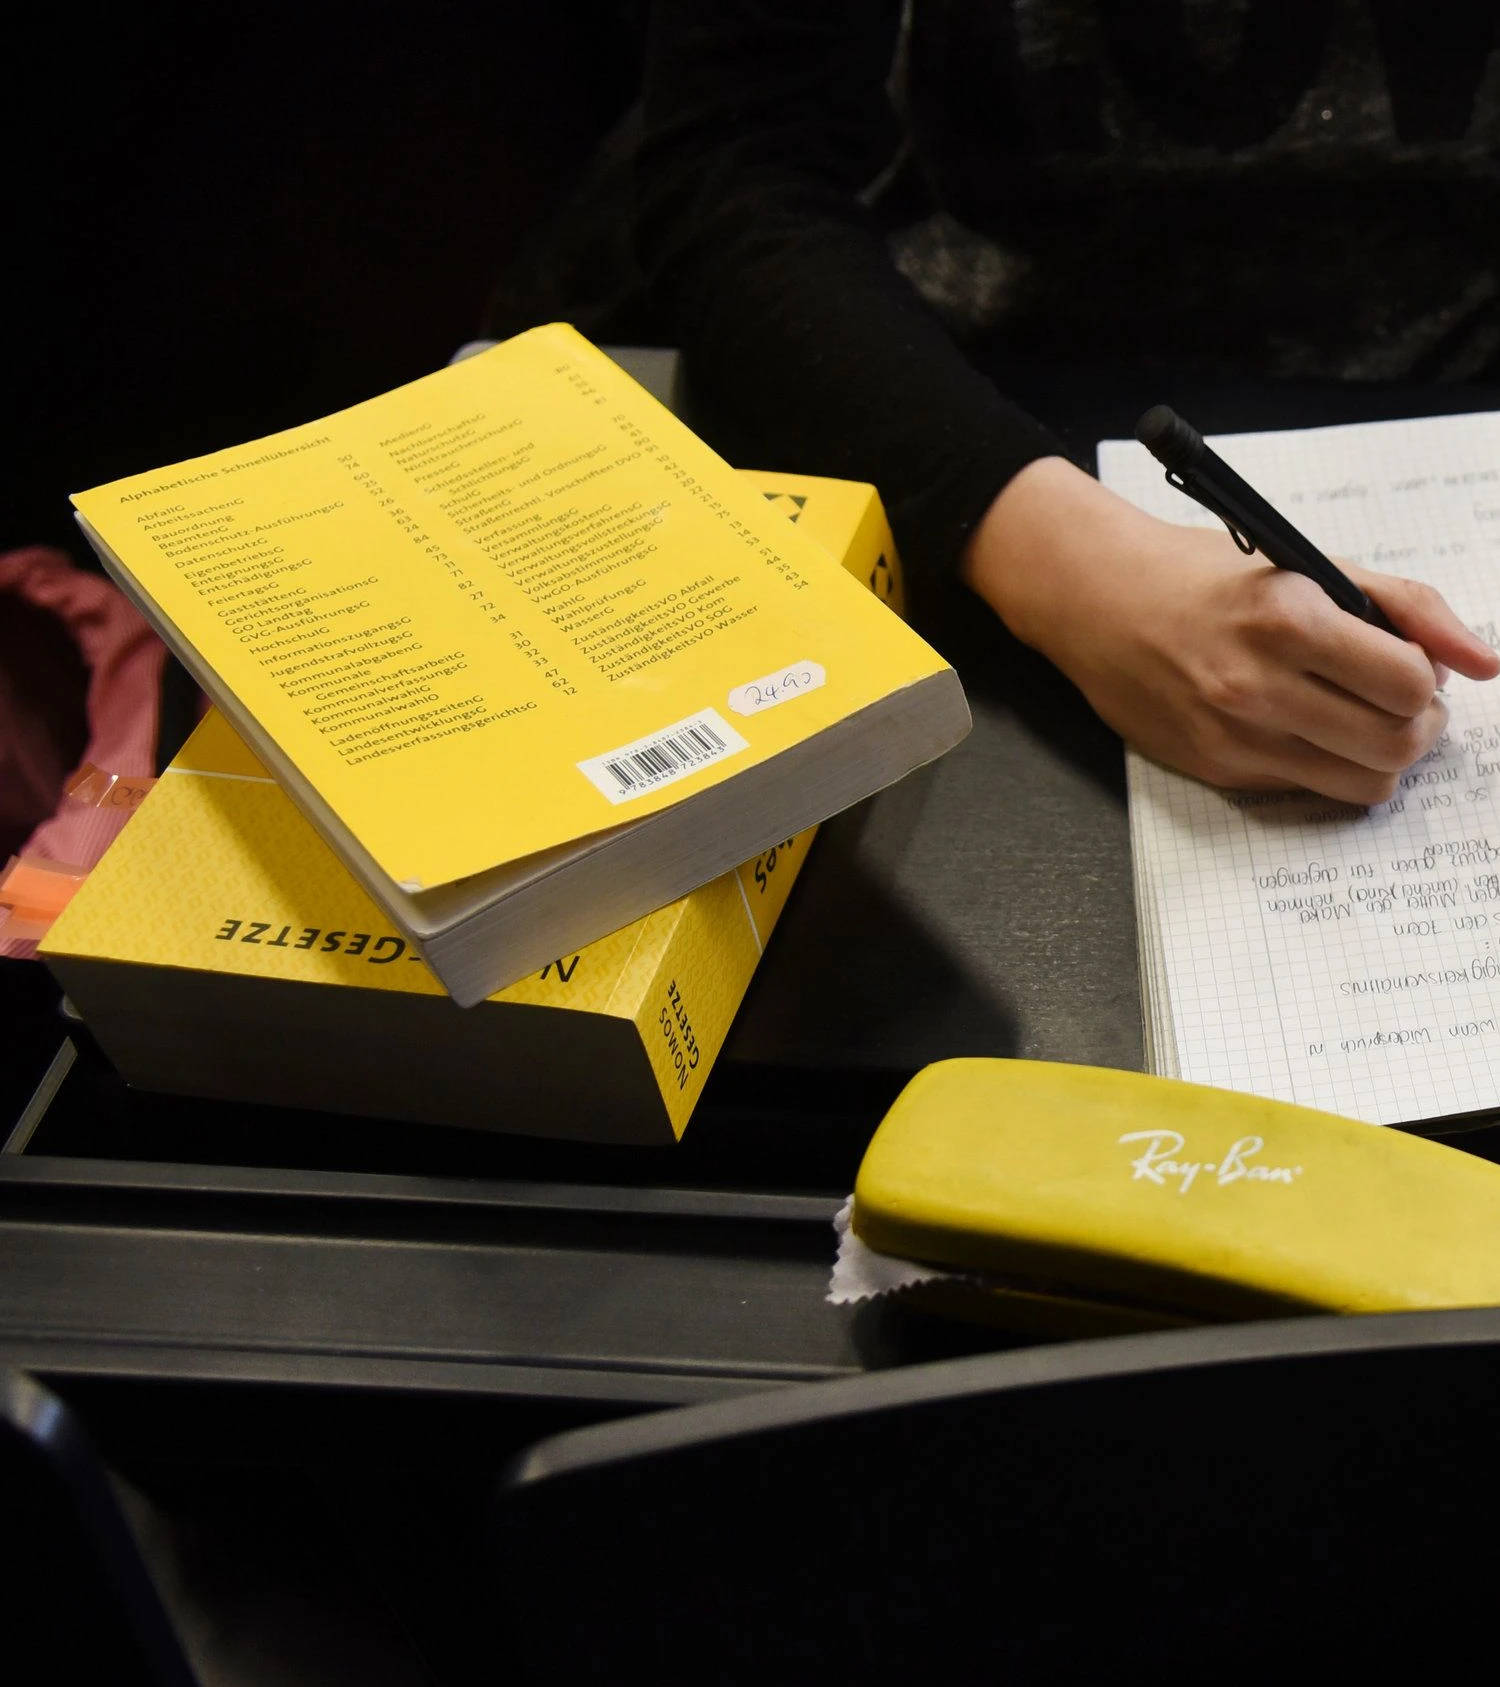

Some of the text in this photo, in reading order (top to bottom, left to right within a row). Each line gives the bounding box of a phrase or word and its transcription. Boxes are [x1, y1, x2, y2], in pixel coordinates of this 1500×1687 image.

[118, 435, 332, 504] Alphabetische Schnellübersicht
[378, 422, 434, 447] MedienG
[388, 412, 487, 457] NachbarschaftsG
[395, 428, 477, 465] NaturschutzG
[403, 418, 524, 473] NichtraucherschutzG
[412, 460, 461, 484] PresseG
[423, 442, 537, 494] Schiedsstellen- und
[135, 454, 353, 523] AbfallG 50
[142, 461, 361, 532] ArbeitssachenG 74
[151, 471, 370, 542] Bauordnung 60
[438, 488, 482, 510] SchulG
[446, 443, 609, 518] Sicherheits- und OrdnungsG
[447, 455, 532, 495] SchlichtungsG
[454, 498, 513, 526] StraßenG
[545, 463, 615, 499] Vorschriften
[614, 451, 644, 466] DVO
[158, 479, 378, 550] BeamtenG 25
[166, 487, 384, 559] Bodenschutz-AusführungsG 52
[175, 497, 395, 569] DatenschutzG 26
[184, 507, 405, 580] EigenbetriebsG 36
[191, 515, 412, 588] EnteignungsG 63
[473, 513, 544, 545] Verfassung
[481, 507, 581, 554] VersammlungsG
[489, 504, 614, 562] VerwaltungskostenG
[497, 477, 696, 570] VerwaltungsverfahrensG 20
[505, 485, 704, 579] VerwaltungsvollstreckungsG 22
[513, 493, 713, 587] VerwaltungszustellungsG 21
[522, 501, 722, 596] VolksabstimmungsG 15
[198, 523, 420, 597] EntschädigungsG 24
[207, 534, 430, 608] FeiertagsG 84
[217, 544, 441, 619] GaststättenG 45
[224, 552, 448, 627] GerichtsorganisationsG 73
[530, 510, 731, 604] VwGO-AusführungsG 75
[542, 520, 743, 616] WahlG 13
[551, 528, 752, 625] WahlprüfungsG 14
[559, 536, 761, 633] WasserG 53
[232, 560, 456, 636] GO Landtag 11
[239, 568, 464, 644] GVG-AusführungsG 71
[249, 580, 473, 655] HochschulG 82
[258, 590, 484, 667] InformationszugangsG 27
[571, 547, 773, 646] ZuständigkeitsVO Abfall 51
[580, 555, 781, 655] ZuständigkeitsVO Gewerbe 44
[588, 563, 791, 664] ZuständigkeitsVO Kom 35
[597, 571, 800, 673] ZuständigkeitsVO SOG 43
[606, 579, 809, 682] ZuständigkeitsVO Wasser 54
[268, 602, 496, 678] JugendstrafvollzugsG 72
[279, 613, 506, 690] KommunalabgabenG 34
[316, 630, 524, 702] GemeinschaftsarbeitG 31
[287, 668, 372, 698] Kommunale
[303, 639, 532, 717] KommunalverfassungsG 30
[310, 648, 541, 726] KommunalwahlG 32
[318, 657, 549, 735] KommunalwahlO 33
[329, 668, 559, 747] LadenöffnungszeitenG 47
[337, 677, 569, 756] LandesentwicklungsG 62
[345, 686, 578, 766] LandesverfassungsgerichtsG 12
[618, 746, 727, 797] 9 783848 723843
[658, 1005, 688, 1091] NOMOS
[666, 978, 700, 1070] GESETZE
[1119, 1128, 1294, 1194] Ray-Ban
